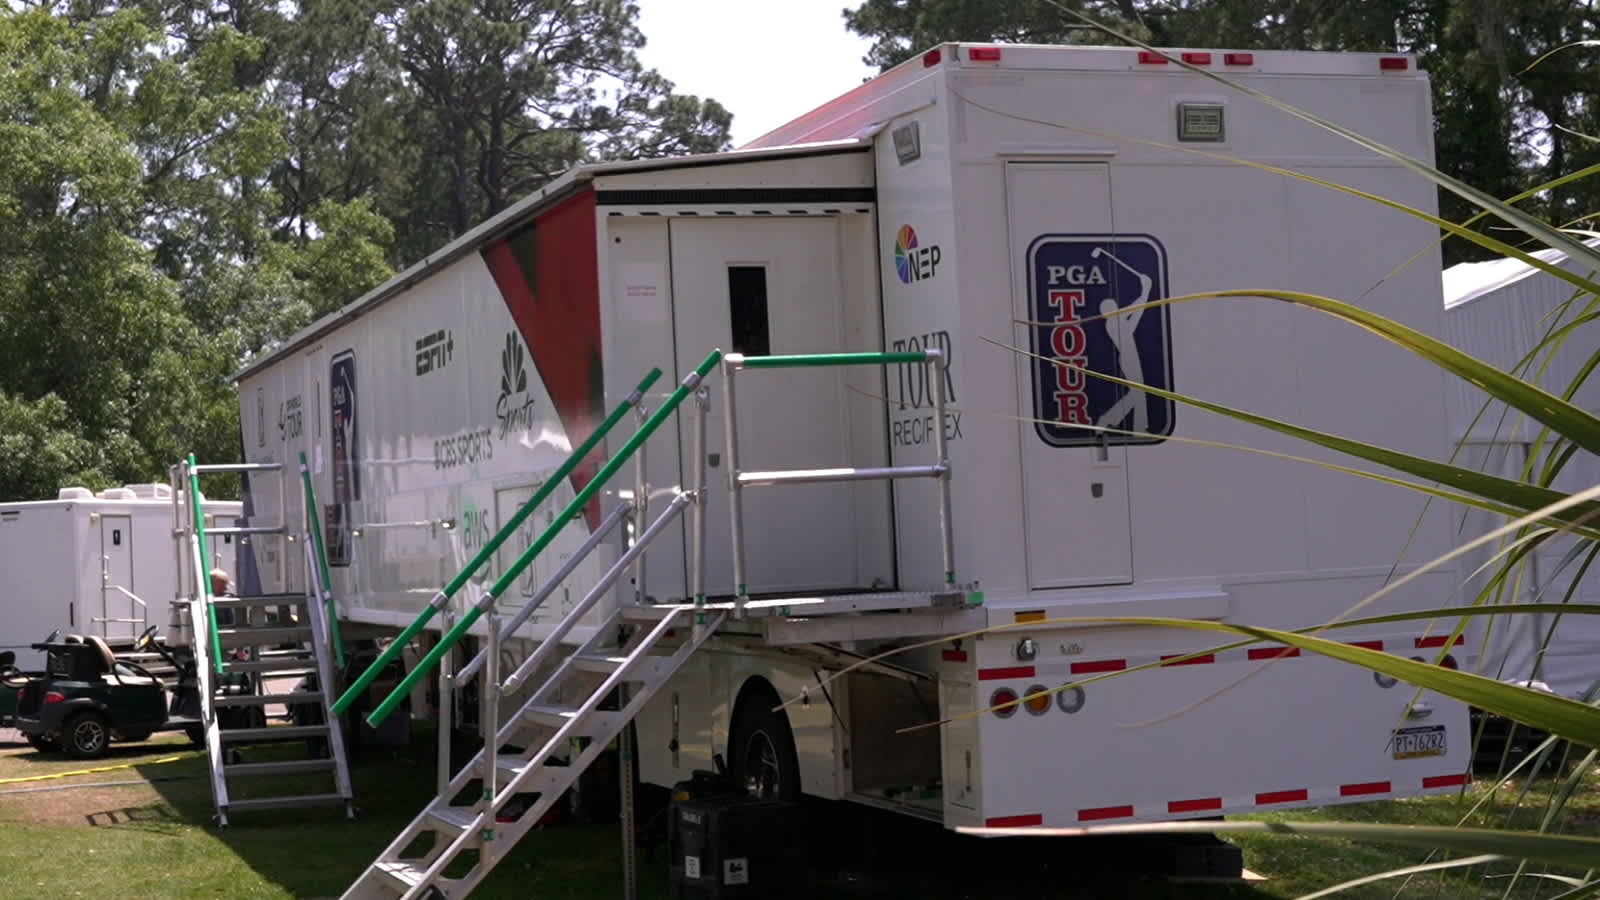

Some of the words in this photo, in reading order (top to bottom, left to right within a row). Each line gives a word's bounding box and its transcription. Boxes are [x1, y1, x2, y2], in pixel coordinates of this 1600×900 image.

[909, 245, 941, 282] NEP
[1047, 265, 1106, 285] PGA
[1047, 288, 1092, 430] TOUR
[496, 392, 536, 443] Sports
[893, 413, 963, 447] REC/FEX
[457, 428, 493, 466] SPORTS
[463, 509, 491, 550] aws
